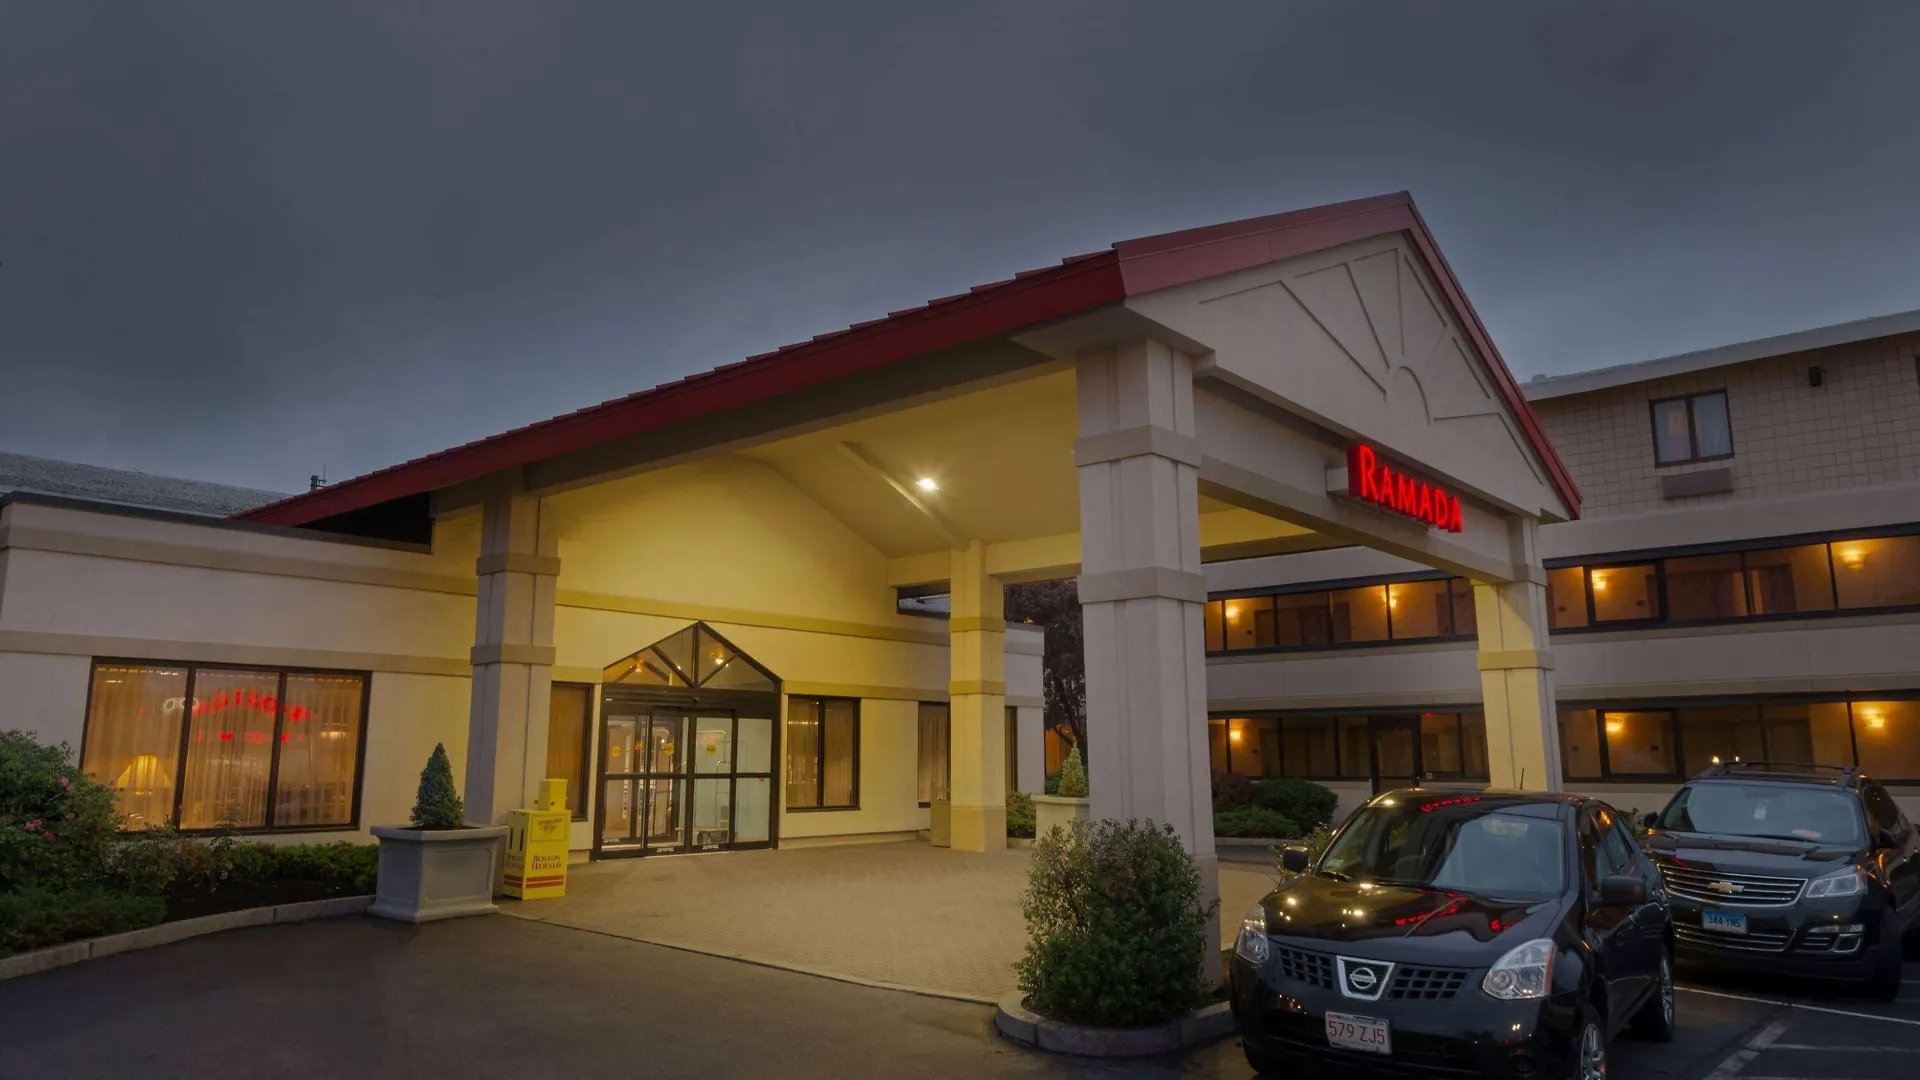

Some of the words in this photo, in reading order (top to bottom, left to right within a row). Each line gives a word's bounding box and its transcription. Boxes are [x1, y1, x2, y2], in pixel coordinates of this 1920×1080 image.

[1358, 443, 1464, 533] RAMADA
[532, 855, 561, 863] BOSTON
[1328, 1020, 1355, 1039] 579
[1359, 1026, 1385, 1045] ZJ5
